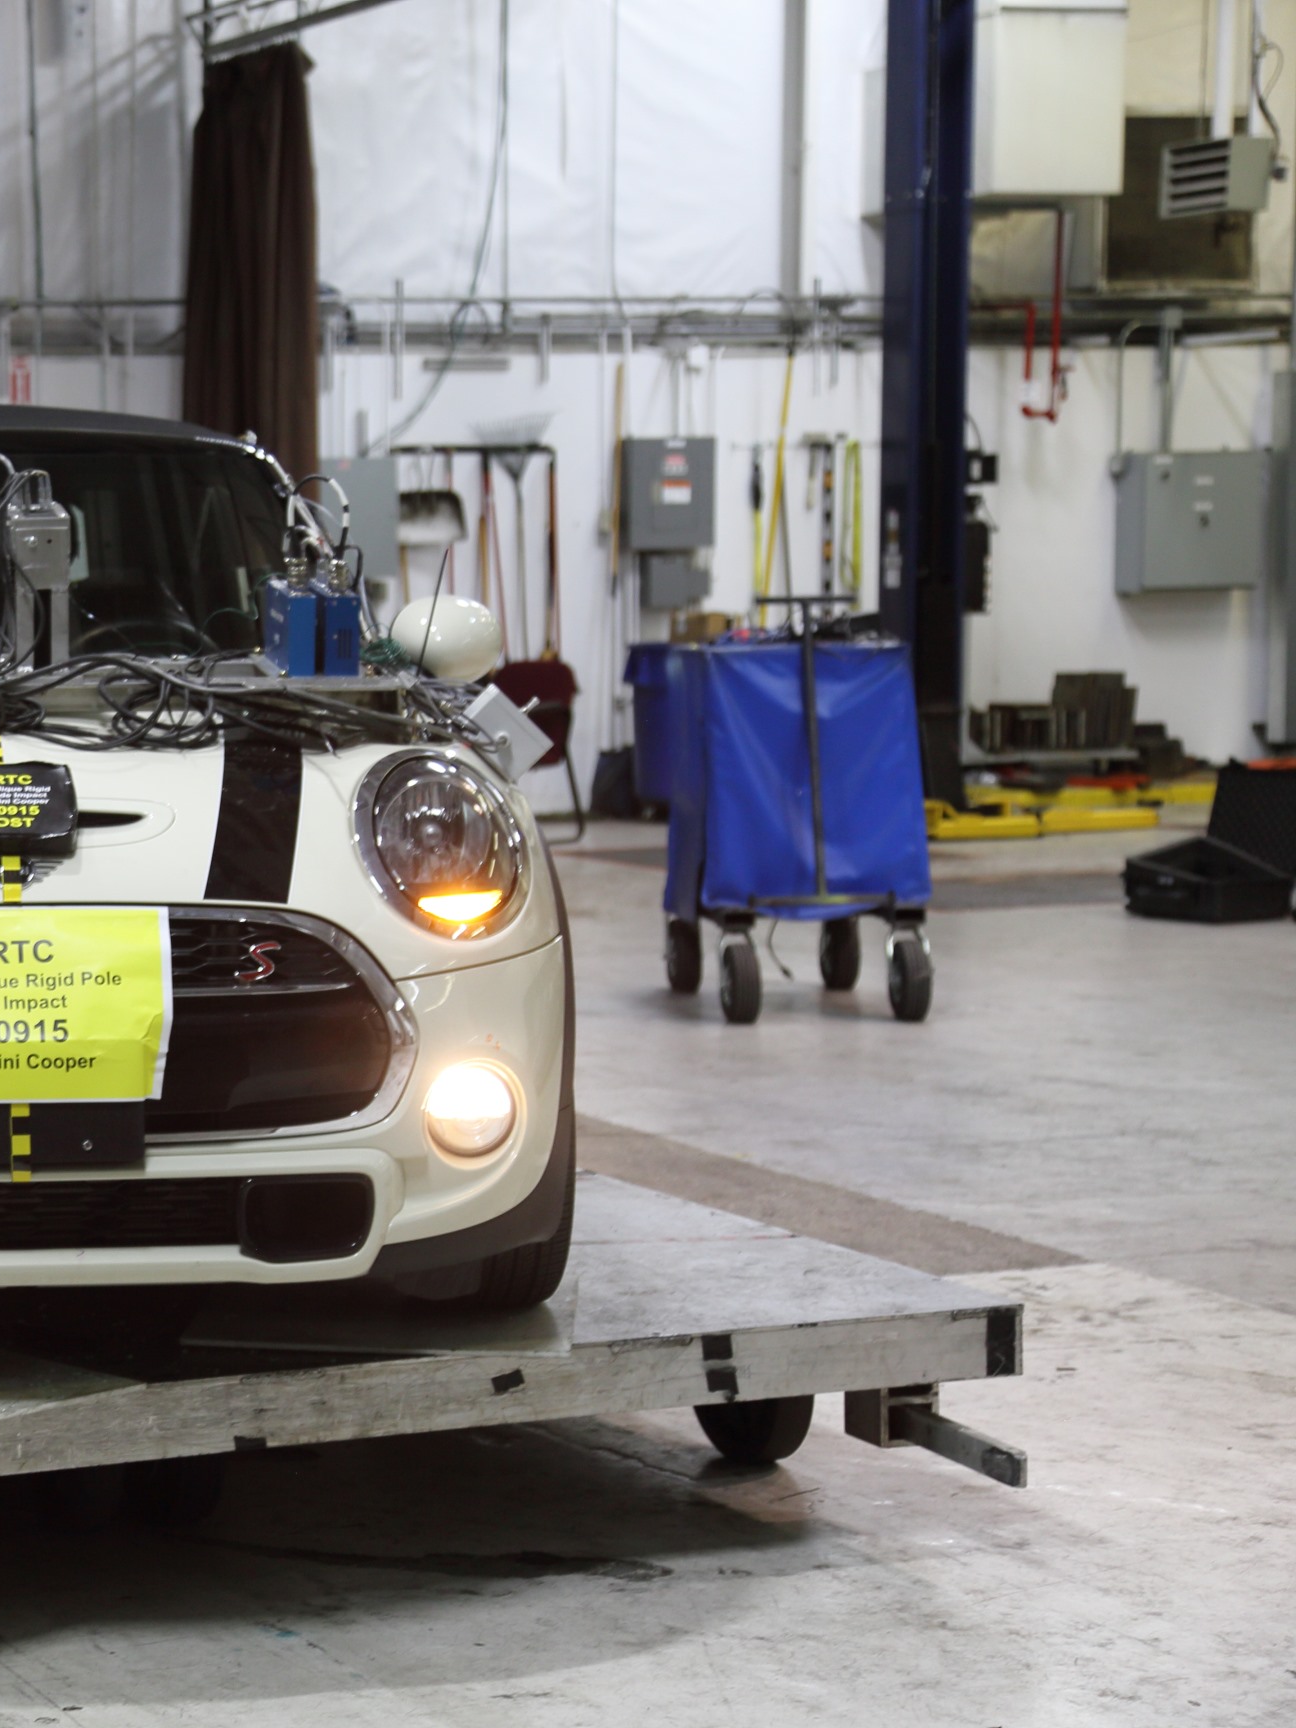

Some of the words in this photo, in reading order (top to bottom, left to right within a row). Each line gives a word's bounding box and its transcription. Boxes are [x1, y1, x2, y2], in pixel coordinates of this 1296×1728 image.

[13, 792, 47, 800] Impact
[233, 940, 282, 983] S
[26, 972, 74, 991] Rigid
[81, 971, 122, 986] Pole
[4, 995, 67, 1012] Impact
[26, 1053, 96, 1072] Cooper
